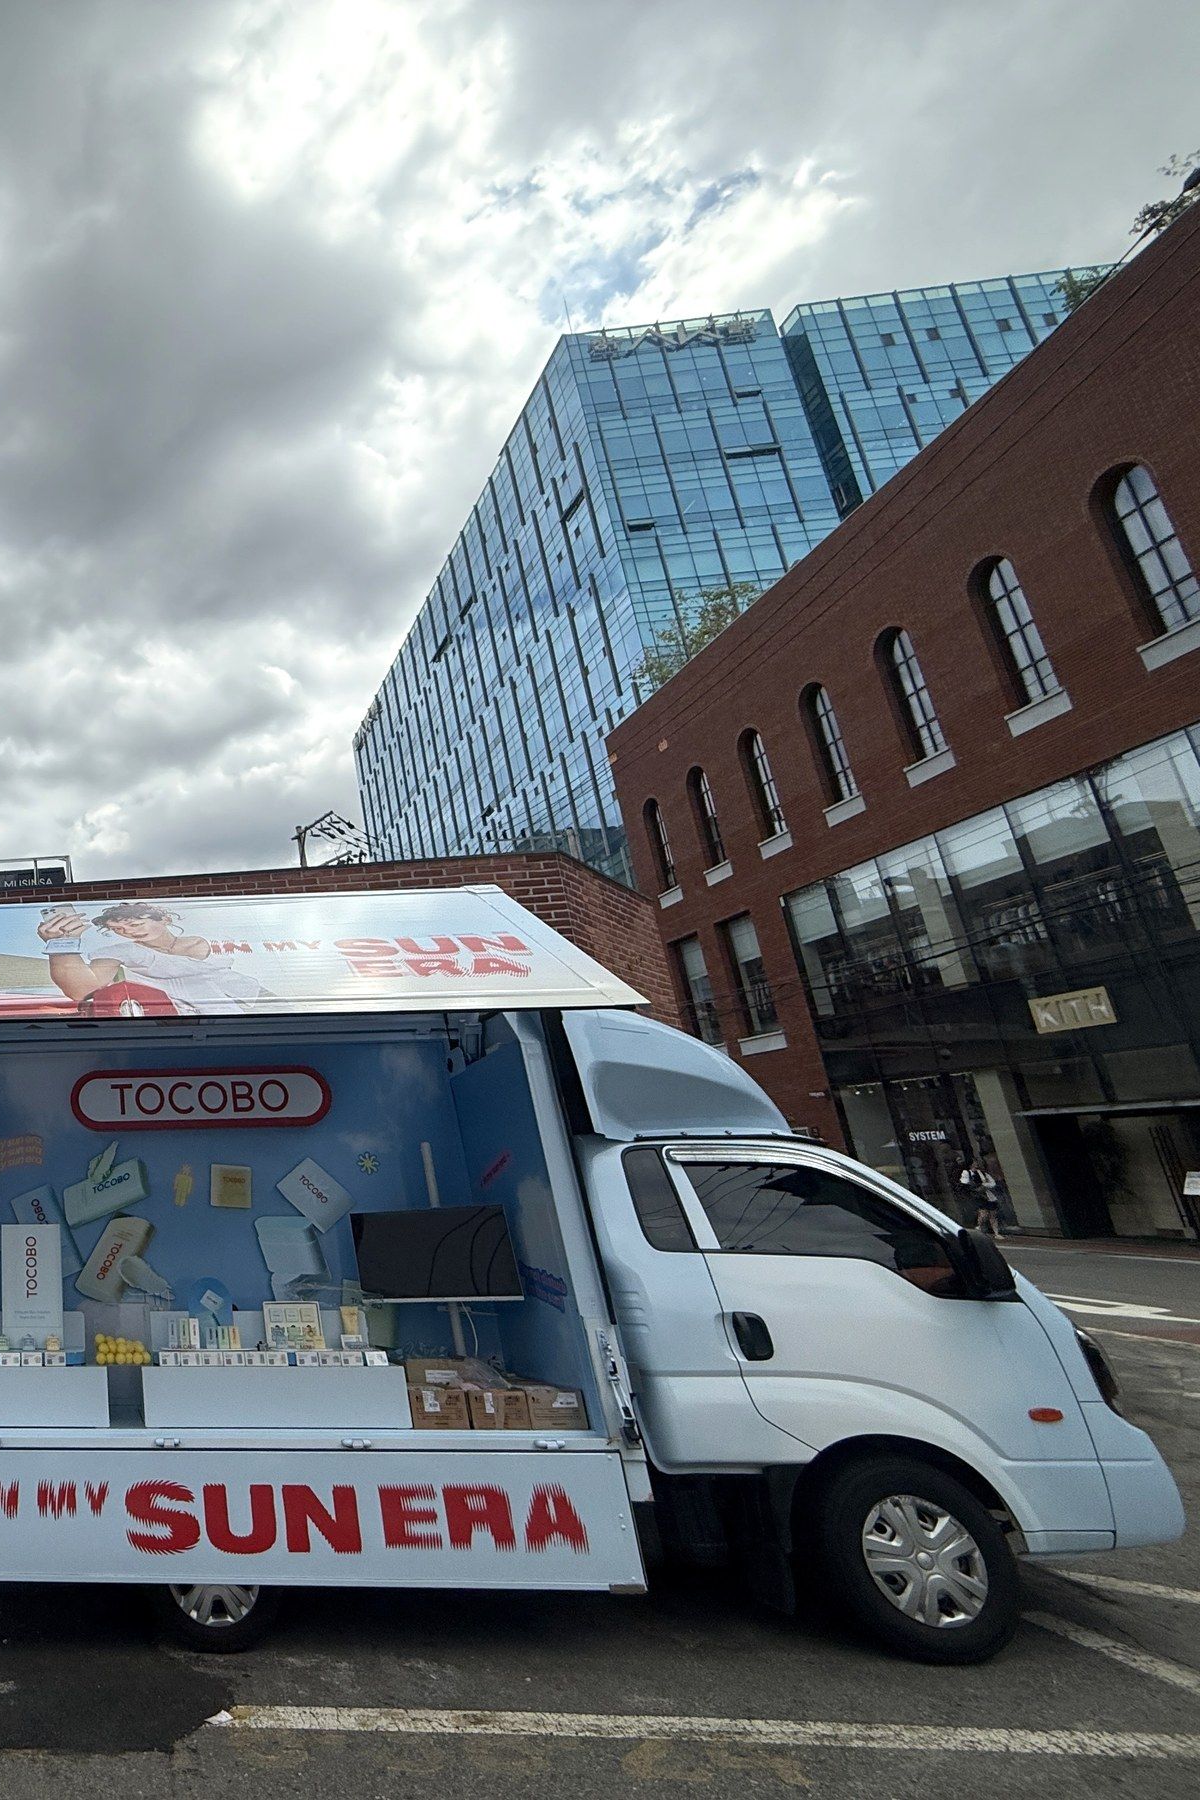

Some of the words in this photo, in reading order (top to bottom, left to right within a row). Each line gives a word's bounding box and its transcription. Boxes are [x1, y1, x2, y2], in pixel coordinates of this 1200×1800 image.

[210, 940, 252, 954] IN
[262, 939, 322, 952] MY
[333, 931, 534, 958] SUN
[346, 954, 532, 978] ERA
[1036, 992, 1110, 1027] KITH
[110, 1079, 289, 1115] TOCOBO
[908, 1130, 946, 1142] SYSTEM
[92, 1172, 131, 1194] TOCOBO
[299, 1175, 328, 1204] TOCOBO
[31, 1198, 49, 1224] OBO
[25, 1236, 38, 1298] TOCOBO
[96, 1242, 123, 1280] TOCOBO
[37, 1479, 110, 1520] MY
[124, 1480, 363, 1555] SUN
[377, 1483, 590, 1555] ERA
